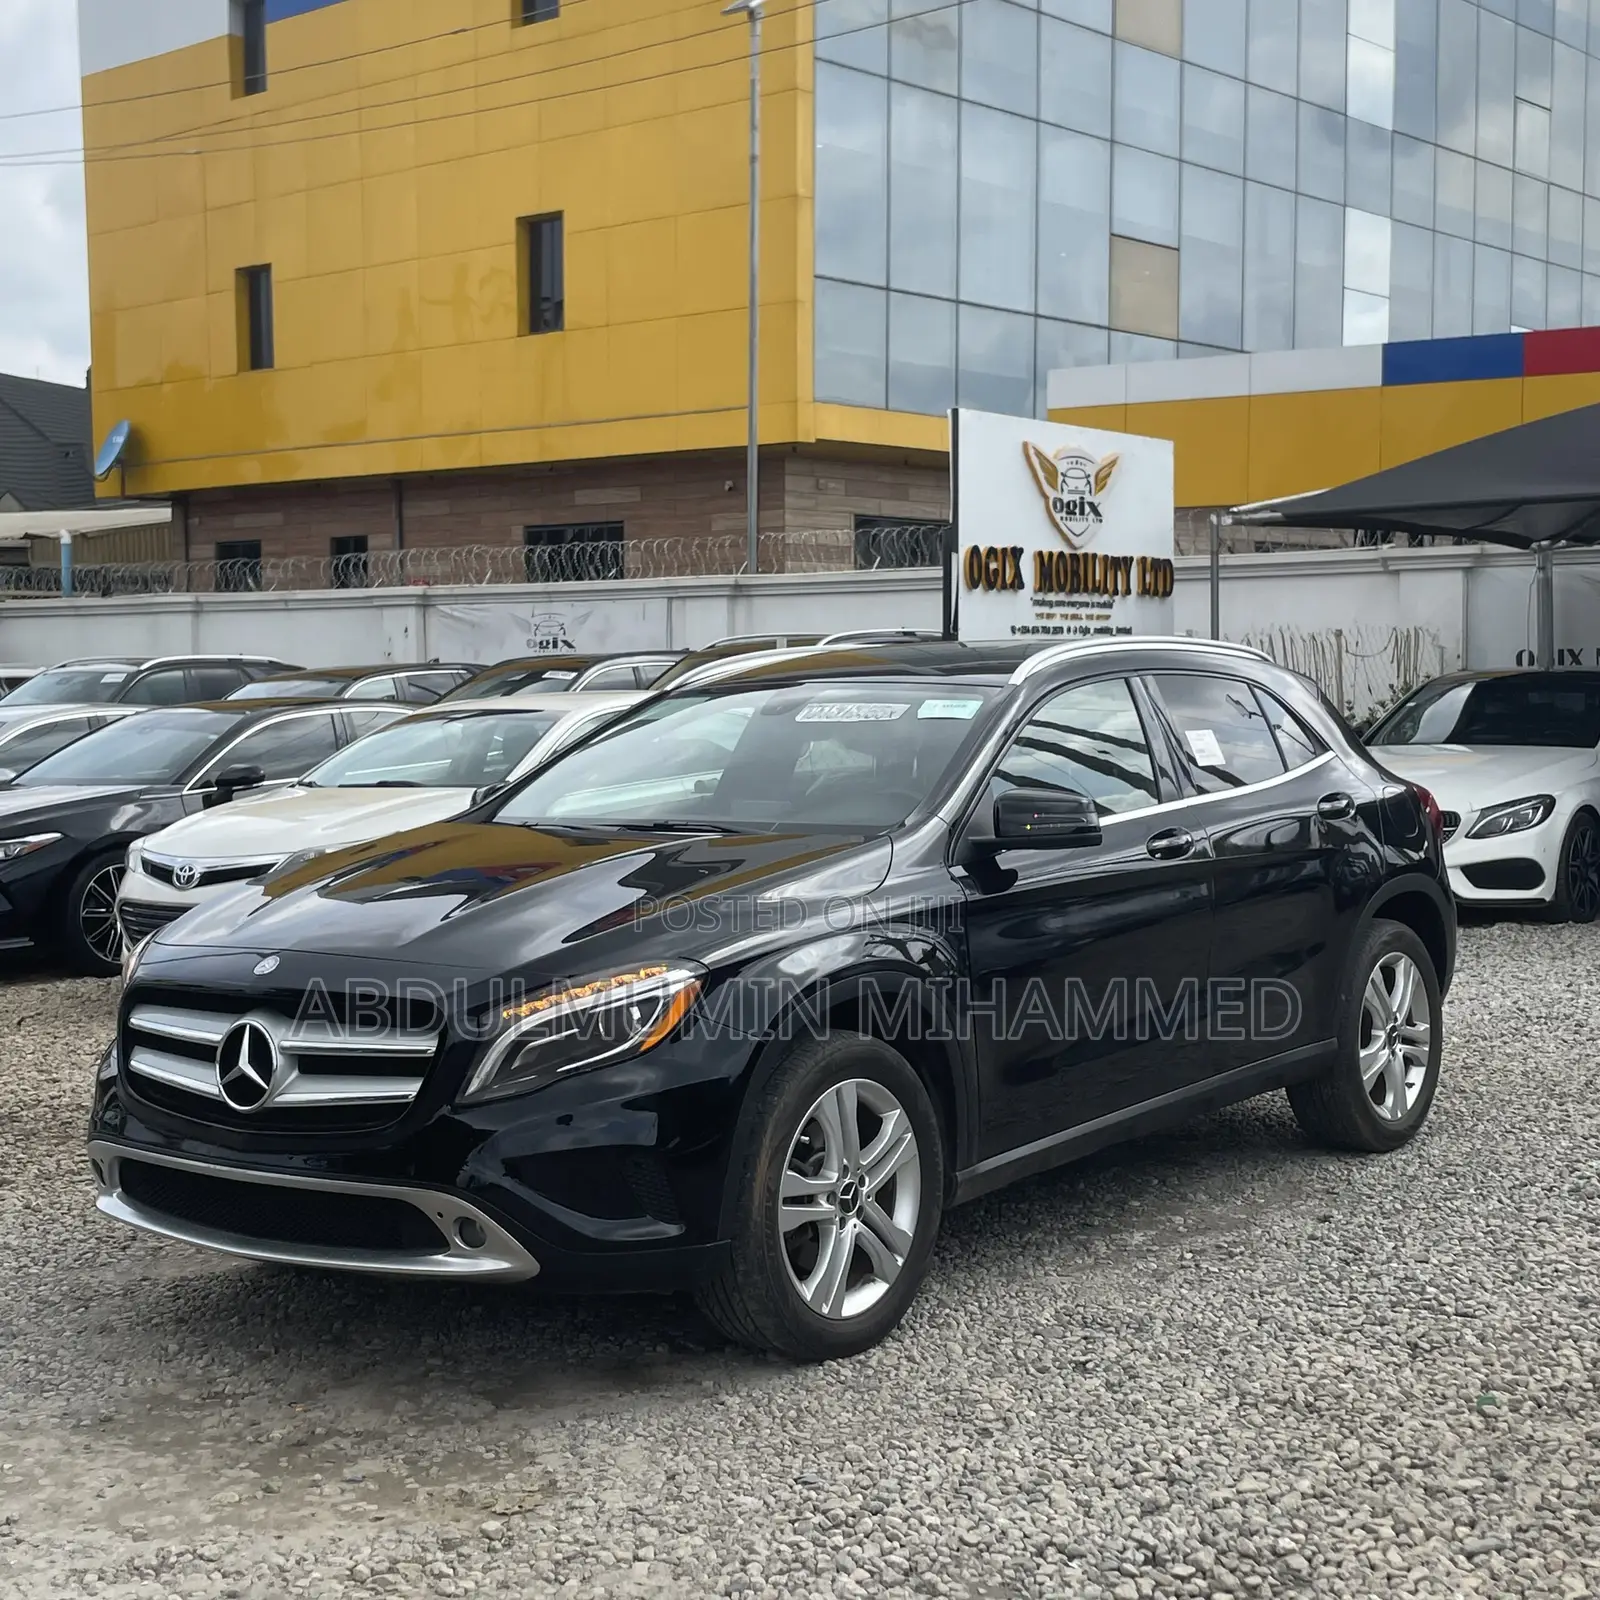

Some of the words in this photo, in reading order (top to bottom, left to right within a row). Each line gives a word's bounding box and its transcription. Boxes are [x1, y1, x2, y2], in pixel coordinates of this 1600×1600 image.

[964, 545, 1025, 591] OGIX
[1033, 550, 1134, 597] MOBILITY
[1136, 556, 1174, 597] LTD
[1515, 648, 1583, 668] OIX
